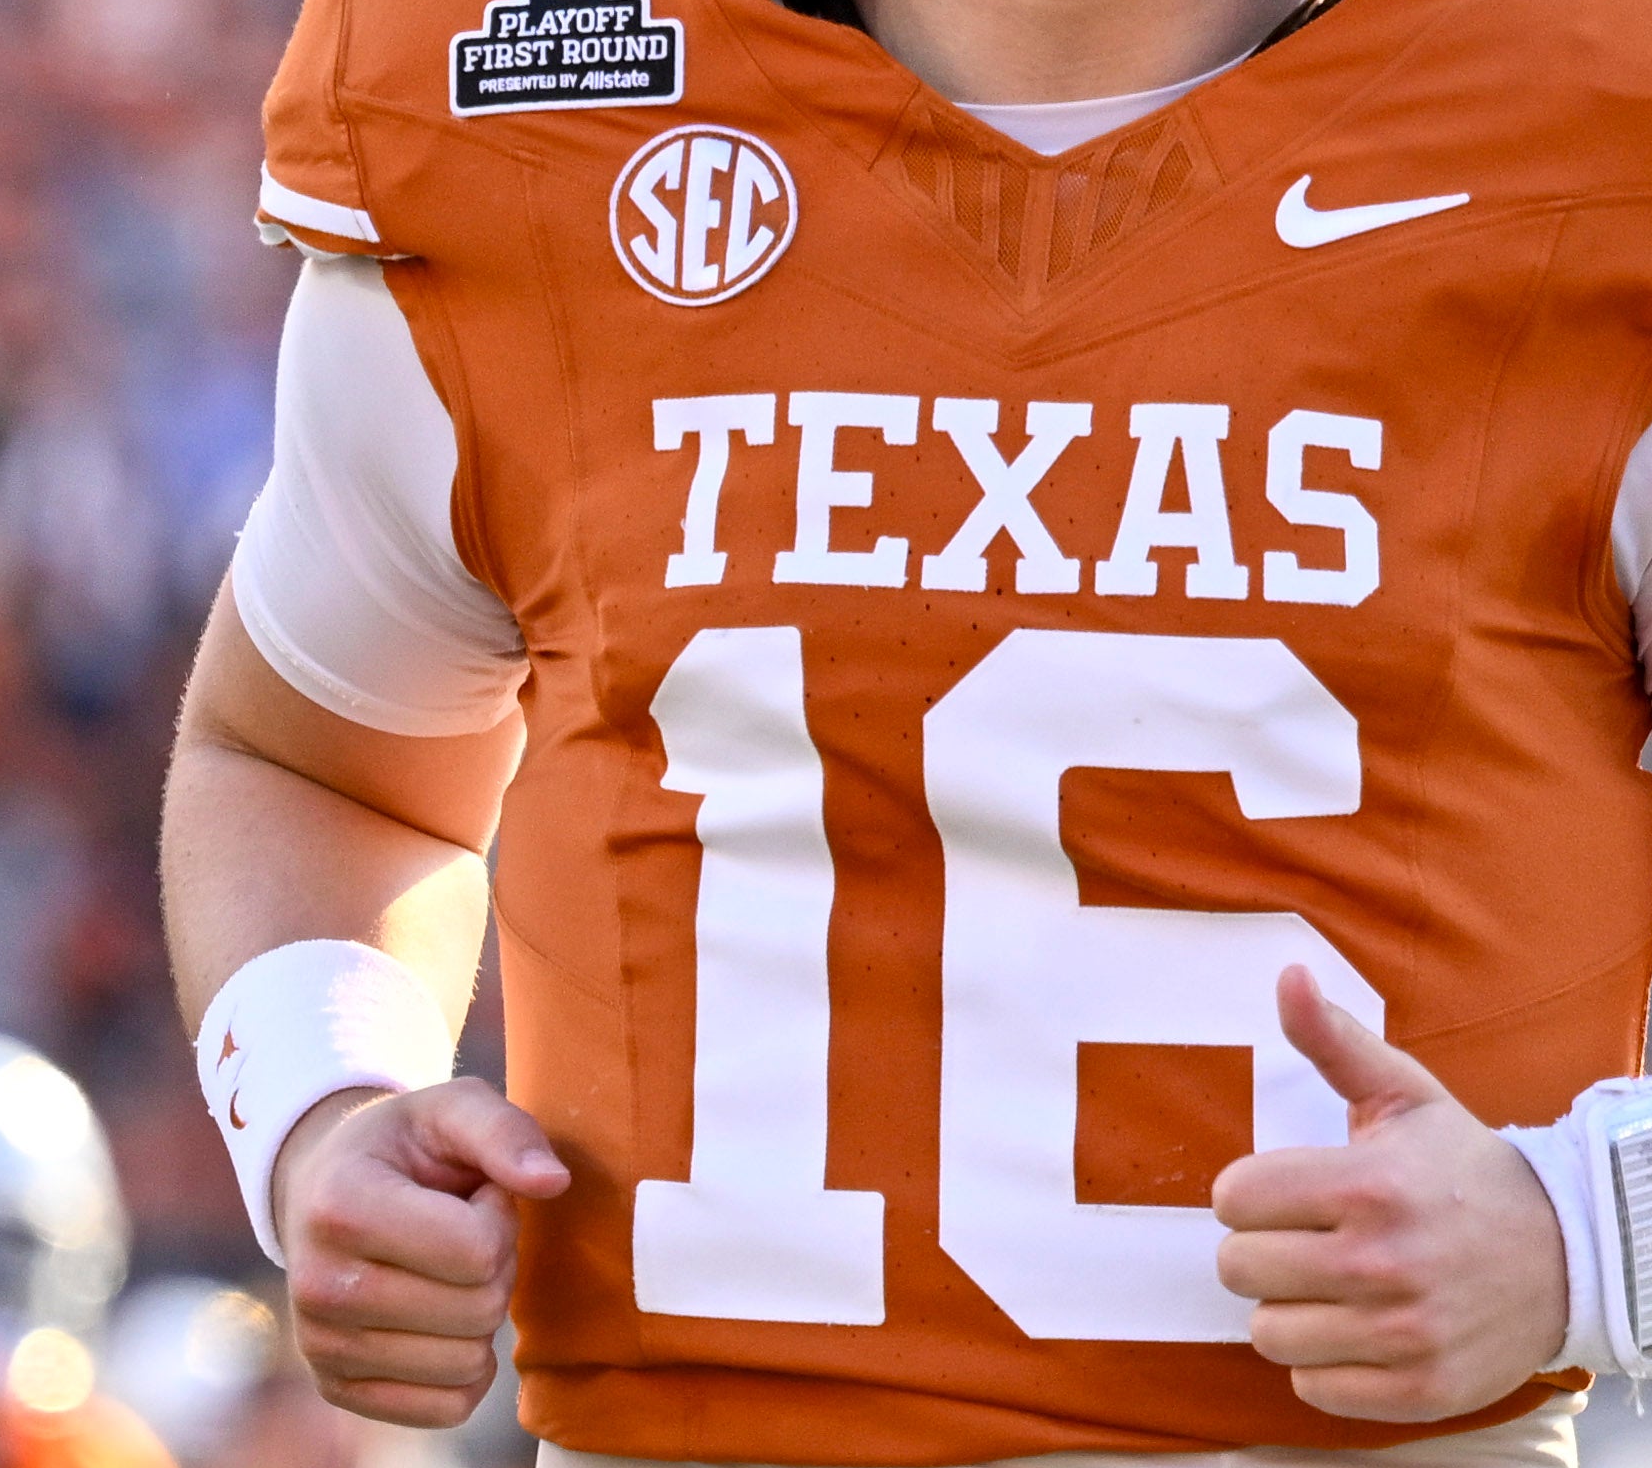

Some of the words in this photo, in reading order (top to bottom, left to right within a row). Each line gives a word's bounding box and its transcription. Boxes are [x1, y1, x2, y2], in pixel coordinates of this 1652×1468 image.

[463, 41, 554, 72] FIRST
[561, 35, 668, 65] ROUND
[497, 6, 634, 38] PLAYOFF
[479, 74, 556, 93] PRESENTED
[559, 73, 578, 88] BY
[580, 69, 650, 91] Allstate
[629, 137, 780, 291] SEC
[652, 391, 1383, 608] TEXAS
[633, 625, 1386, 1344] 16
